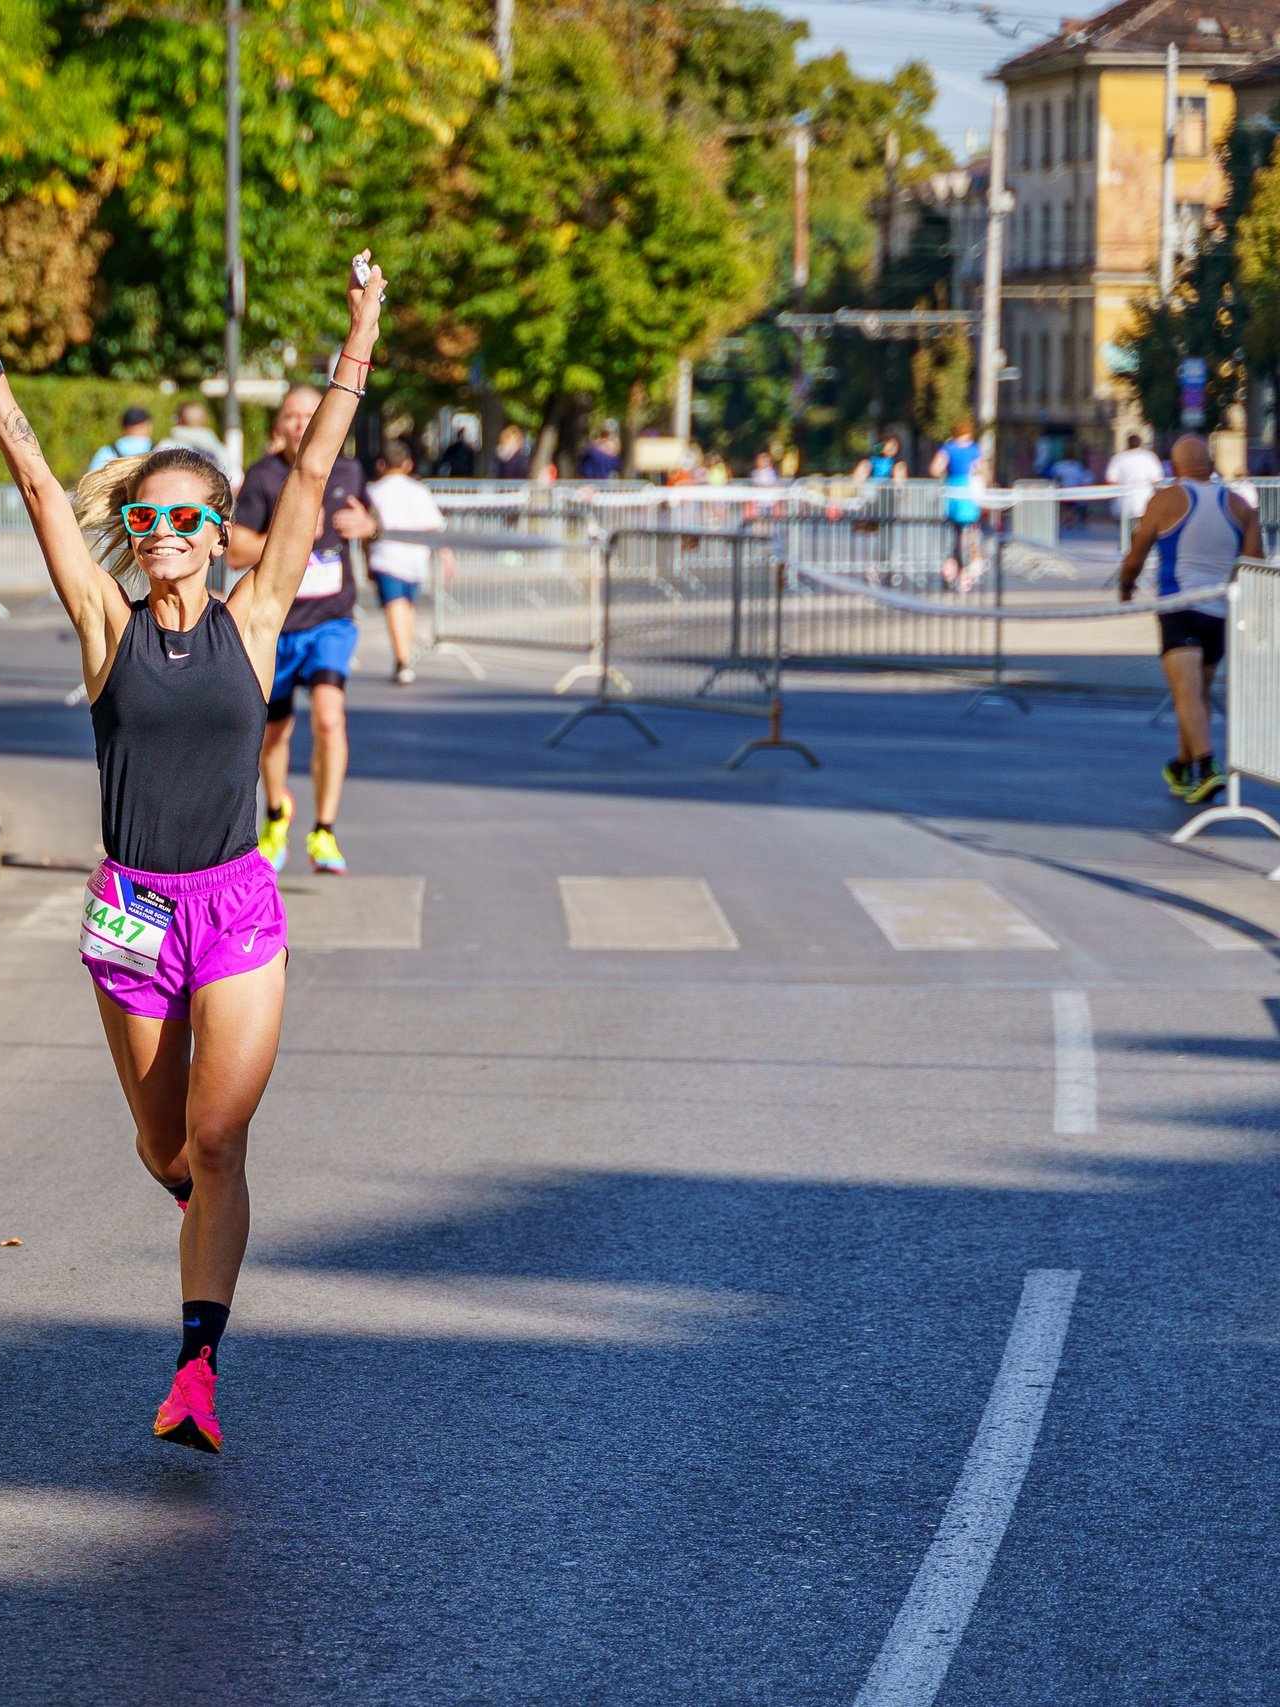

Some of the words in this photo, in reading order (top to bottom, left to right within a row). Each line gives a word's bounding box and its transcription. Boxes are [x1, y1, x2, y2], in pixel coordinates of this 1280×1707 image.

[136, 894, 158, 908] GARMIN
[158, 904, 172, 913] RUN
[147, 891, 156, 900] 10
[155, 895, 165, 904] km
[85, 899, 146, 943] 4447
[128, 906, 156, 922] MARATHON
[130, 901, 144, 911] WIZZ
[144, 908, 154, 916] AIR
[154, 912, 169, 922] SOFIA
